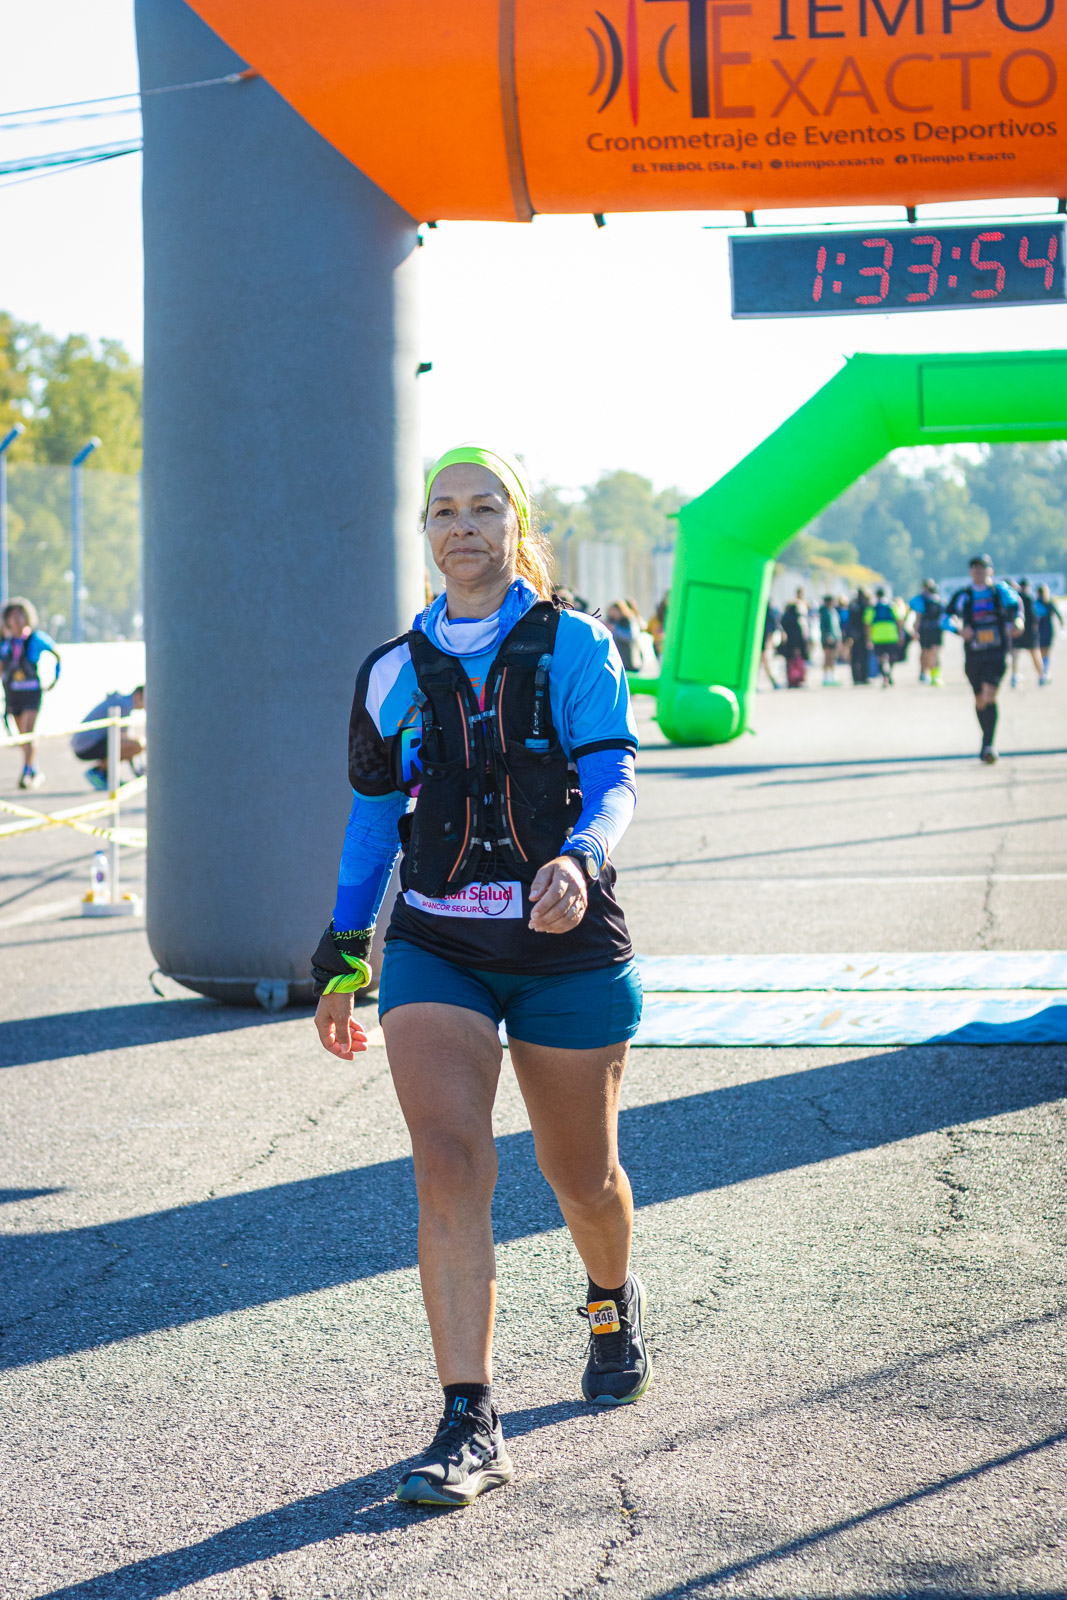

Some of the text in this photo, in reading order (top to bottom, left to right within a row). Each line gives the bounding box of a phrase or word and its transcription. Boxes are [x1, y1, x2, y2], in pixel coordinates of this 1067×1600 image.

[587, 119, 1058, 152] Cronometraje de Eventos Deportivos
[632, 151, 1016, 173] EL TREBOL (Sta. Fe) tiempo.exacto Tiempo Exacto
[812, 231, 1059, 305] 1:33:54
[468, 886, 513, 901] Salud
[451, 905, 490, 914] SEGUROS
[594, 1311, 614, 1324] 646
